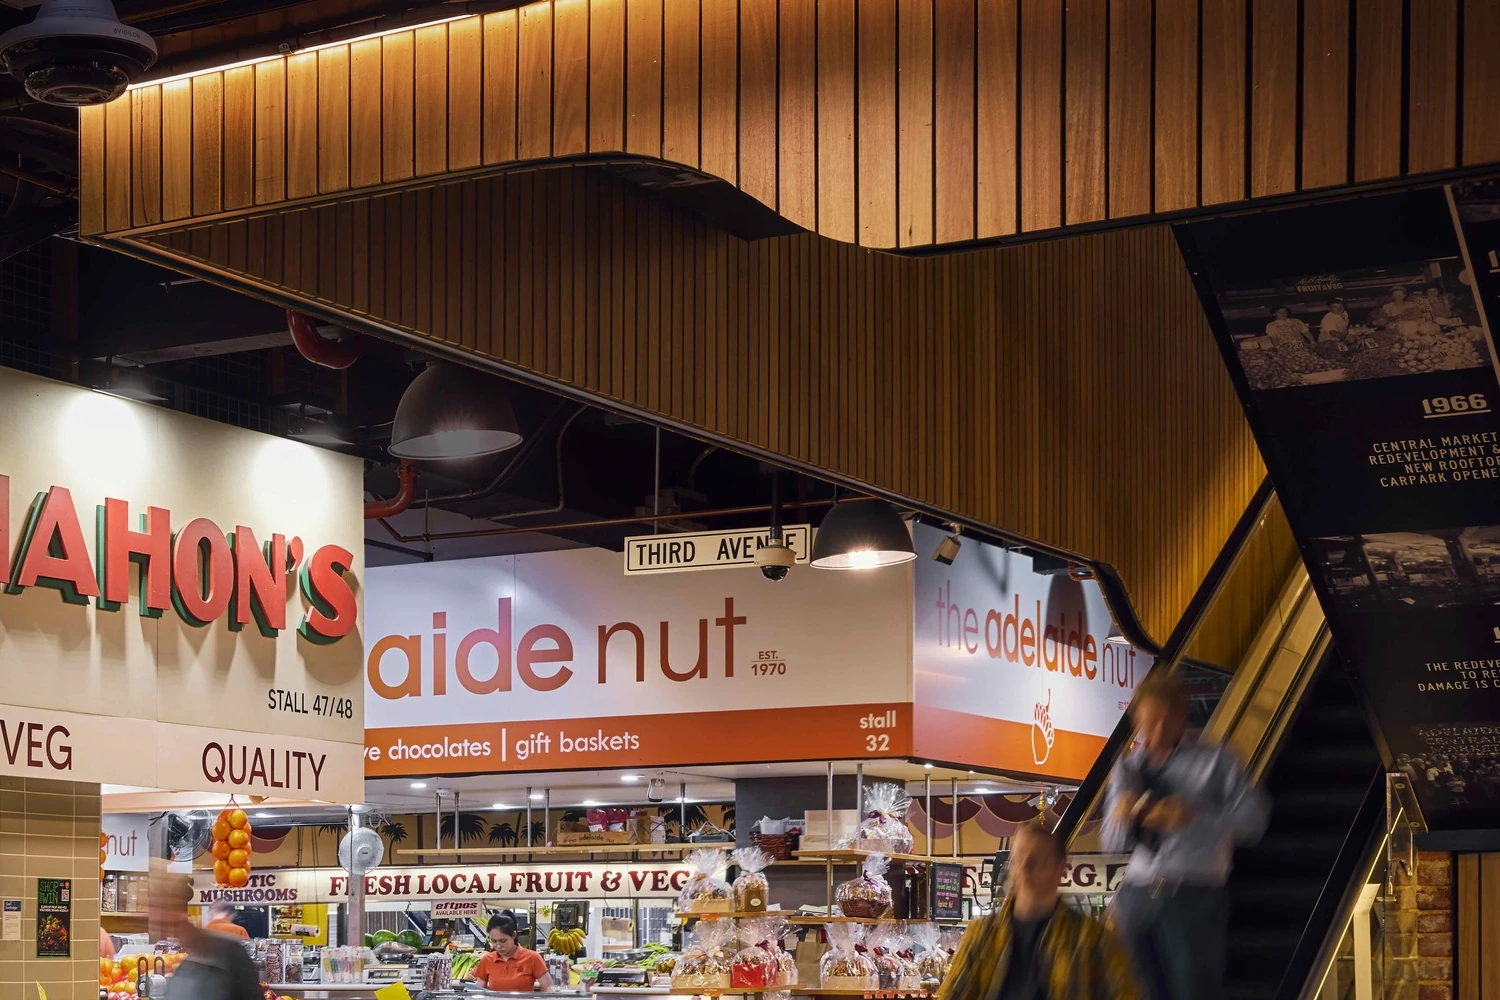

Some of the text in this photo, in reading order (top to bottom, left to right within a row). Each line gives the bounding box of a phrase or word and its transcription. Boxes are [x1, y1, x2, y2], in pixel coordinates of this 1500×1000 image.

[1421, 393, 1488, 415] 1966
[1372, 431, 1498, 453] CENTRAL MARKET
[1368, 445, 1485, 465] REDEVELOPMENT
[1404, 461, 1434, 474] NEW
[1380, 472, 1448, 488] CARPARK
[636, 533, 796, 566] THIRD AVENE
[936, 579, 1136, 690] the adelaide nut
[367, 597, 748, 699] aide nut
[757, 650, 780, 661] EST.
[750, 661, 787, 676] 1970
[1425, 662, 1450, 672] THE
[1461, 671, 1477, 680] TO
[1417, 679, 1489, 692] DAMAGE IS
[267, 688, 354, 720] STALL 47/48
[858, 711, 897, 730] stall
[0, 719, 73, 771] VEG
[388, 736, 491, 760] chocolates
[515, 727, 640, 757] gift baskets
[865, 734, 890, 753] 32
[201, 740, 327, 792] QUALITY
[106, 830, 138, 857] nut
[329, 868, 691, 896] FESH LOCAL FRUIT & VEG
[200, 887, 298, 903] MUSHROOMS
[435, 900, 479, 911] eftpos
[435, 908, 461, 916] AVAILABLE
